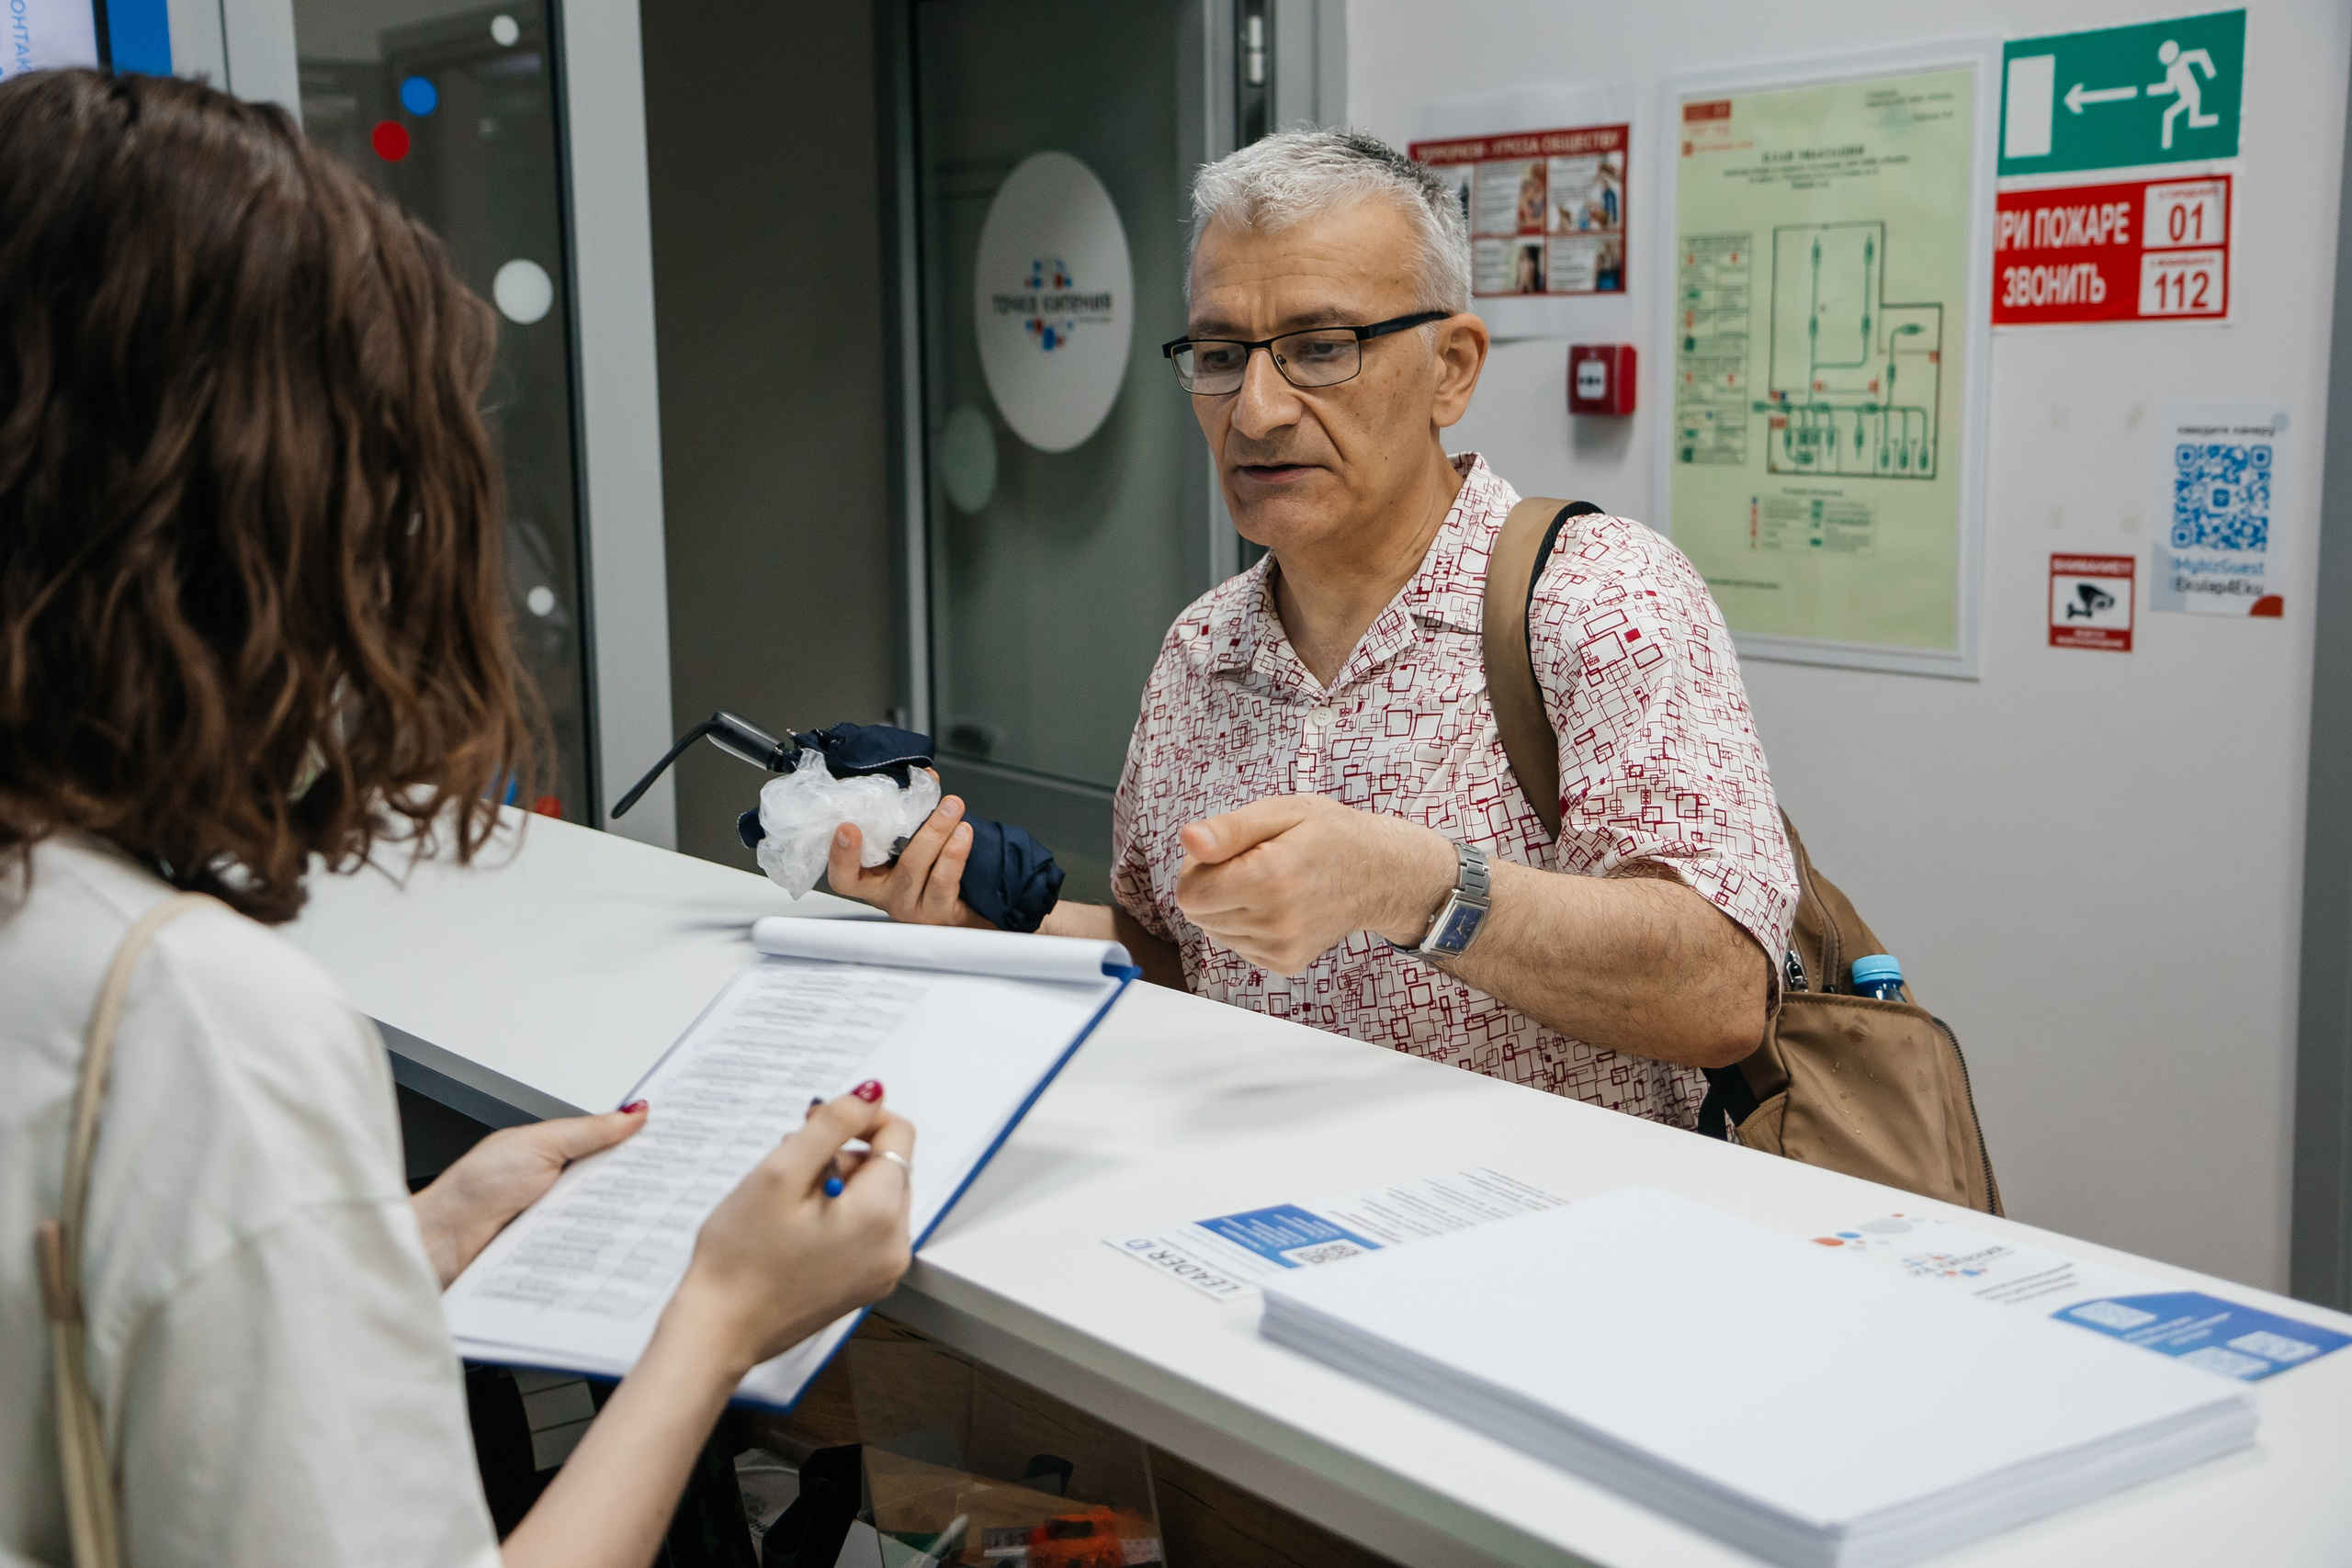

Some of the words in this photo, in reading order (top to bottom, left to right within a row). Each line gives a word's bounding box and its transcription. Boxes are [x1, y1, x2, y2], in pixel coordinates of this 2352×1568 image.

[2033, 201, 2131, 249] ПОЖАРЕ
[2168, 200, 2203, 243] 01
[2001, 263, 2106, 308] ЗВОНИТЬ
[2155, 271, 2209, 310] 112
[1125, 1238, 1157, 1250] ID
[1148, 1249, 1240, 1292] LEADER
